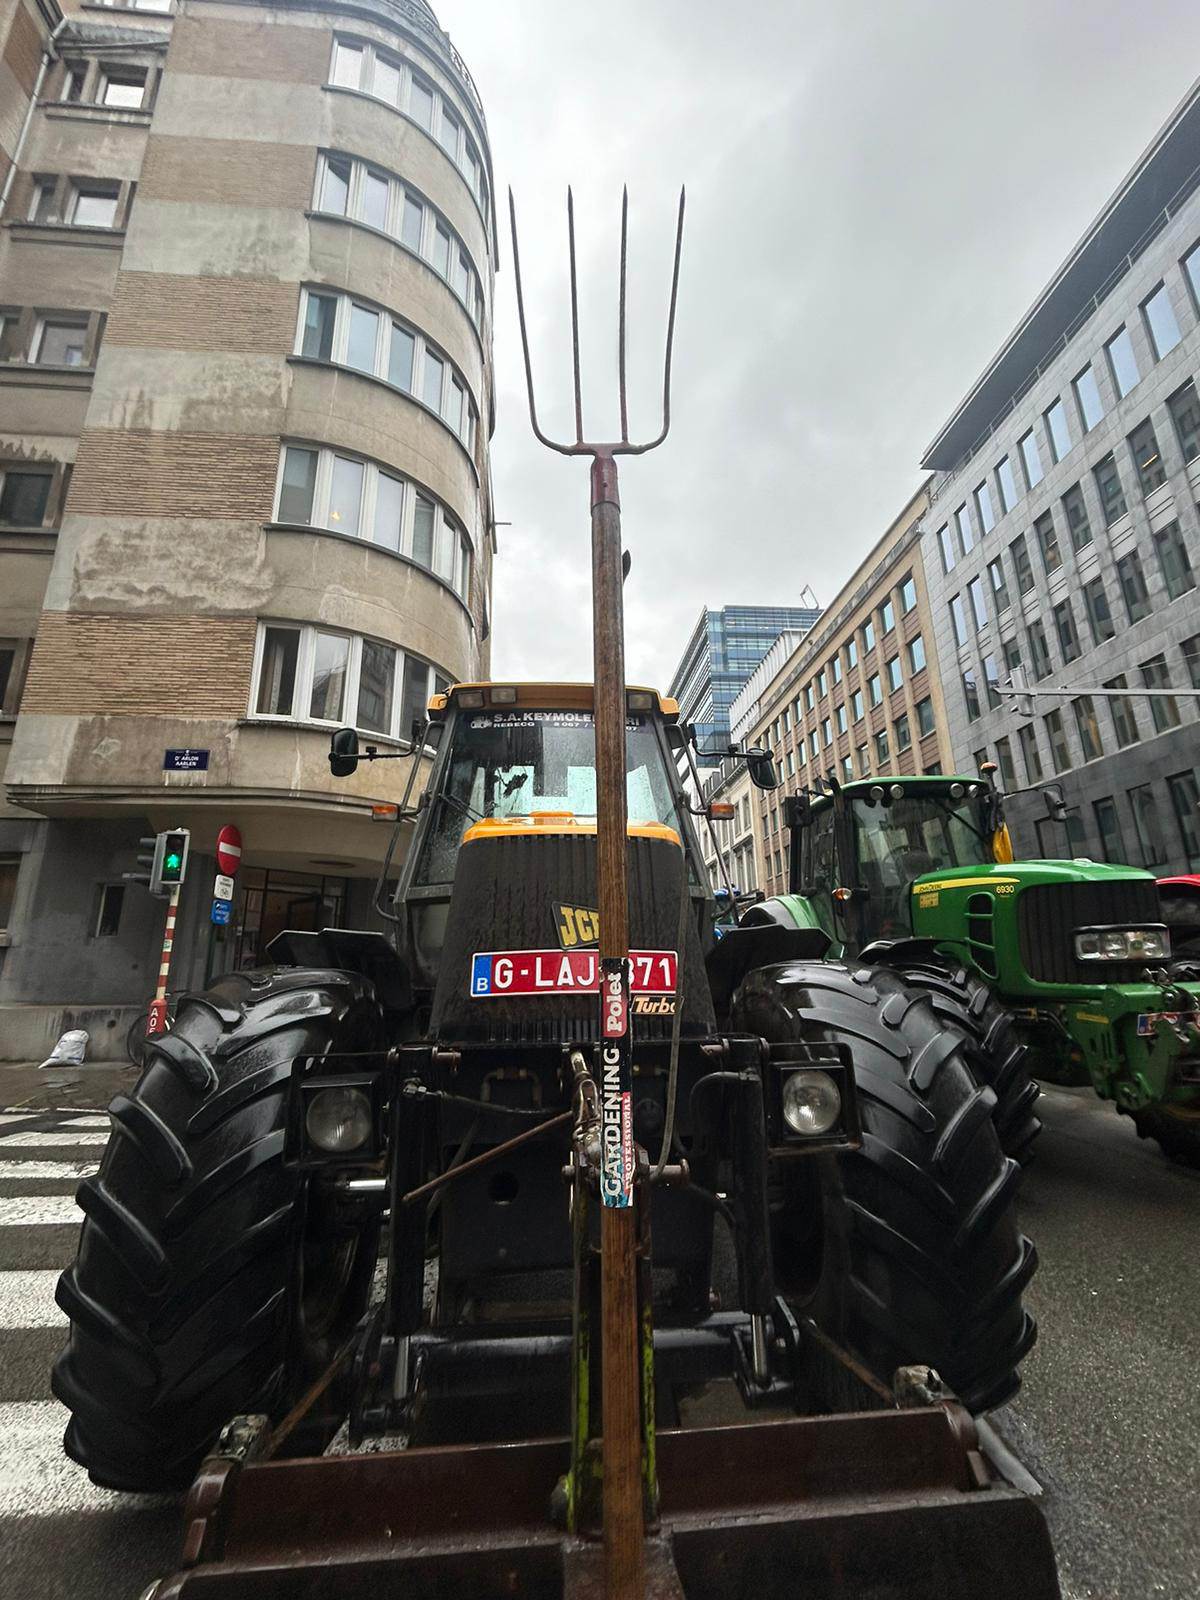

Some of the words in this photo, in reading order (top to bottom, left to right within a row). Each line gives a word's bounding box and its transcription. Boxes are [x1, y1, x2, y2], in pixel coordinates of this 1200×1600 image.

[493, 713, 521, 723] S.A.
[523, 712, 595, 722] KEYMOLE
[996, 885, 1015, 894] 6930
[476, 977, 489, 992] B
[606, 971, 624, 1033] Polet
[603, 1047, 621, 1197] GARDENING
